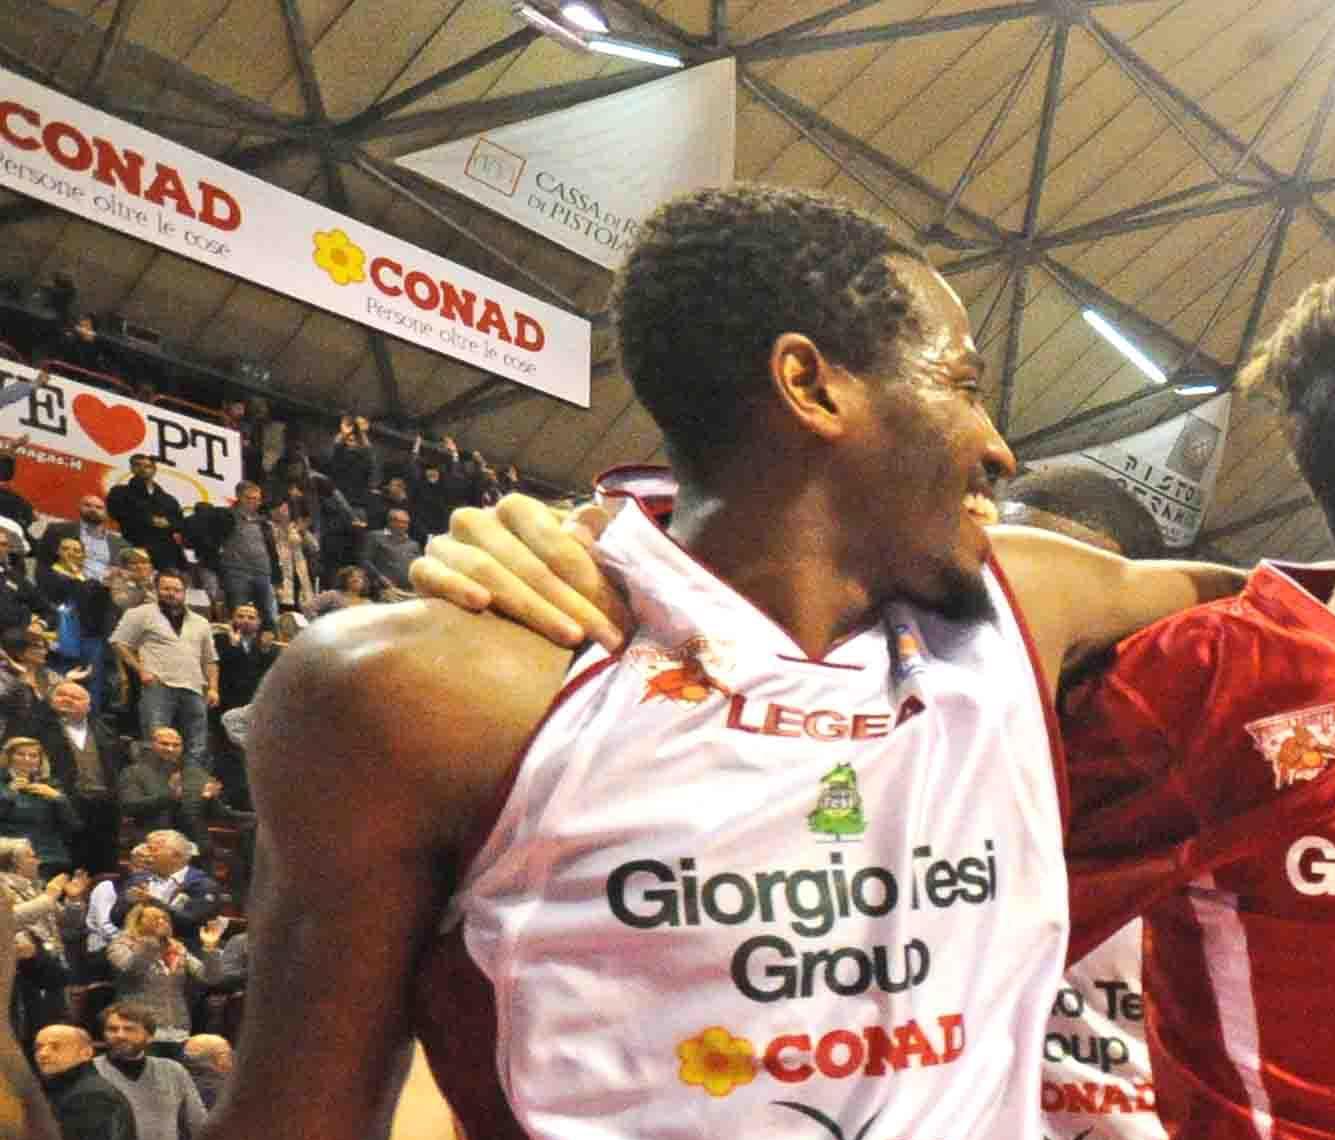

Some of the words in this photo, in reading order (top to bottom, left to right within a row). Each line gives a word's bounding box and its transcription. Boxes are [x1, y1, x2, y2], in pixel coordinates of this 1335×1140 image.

[0, 101, 242, 232] CONAD
[535, 170, 602, 219] CASSA
[93, 191, 149, 226] oltre
[157, 211, 177, 235] le
[366, 297, 433, 336] Persone
[438, 327, 480, 352] oltre
[370, 256, 545, 352] CONAD
[146, 413, 230, 482] PT
[724, 692, 928, 742] LEGEA
[605, 850, 898, 938] Giorgio
[763, 1011, 965, 1082] CONAD
